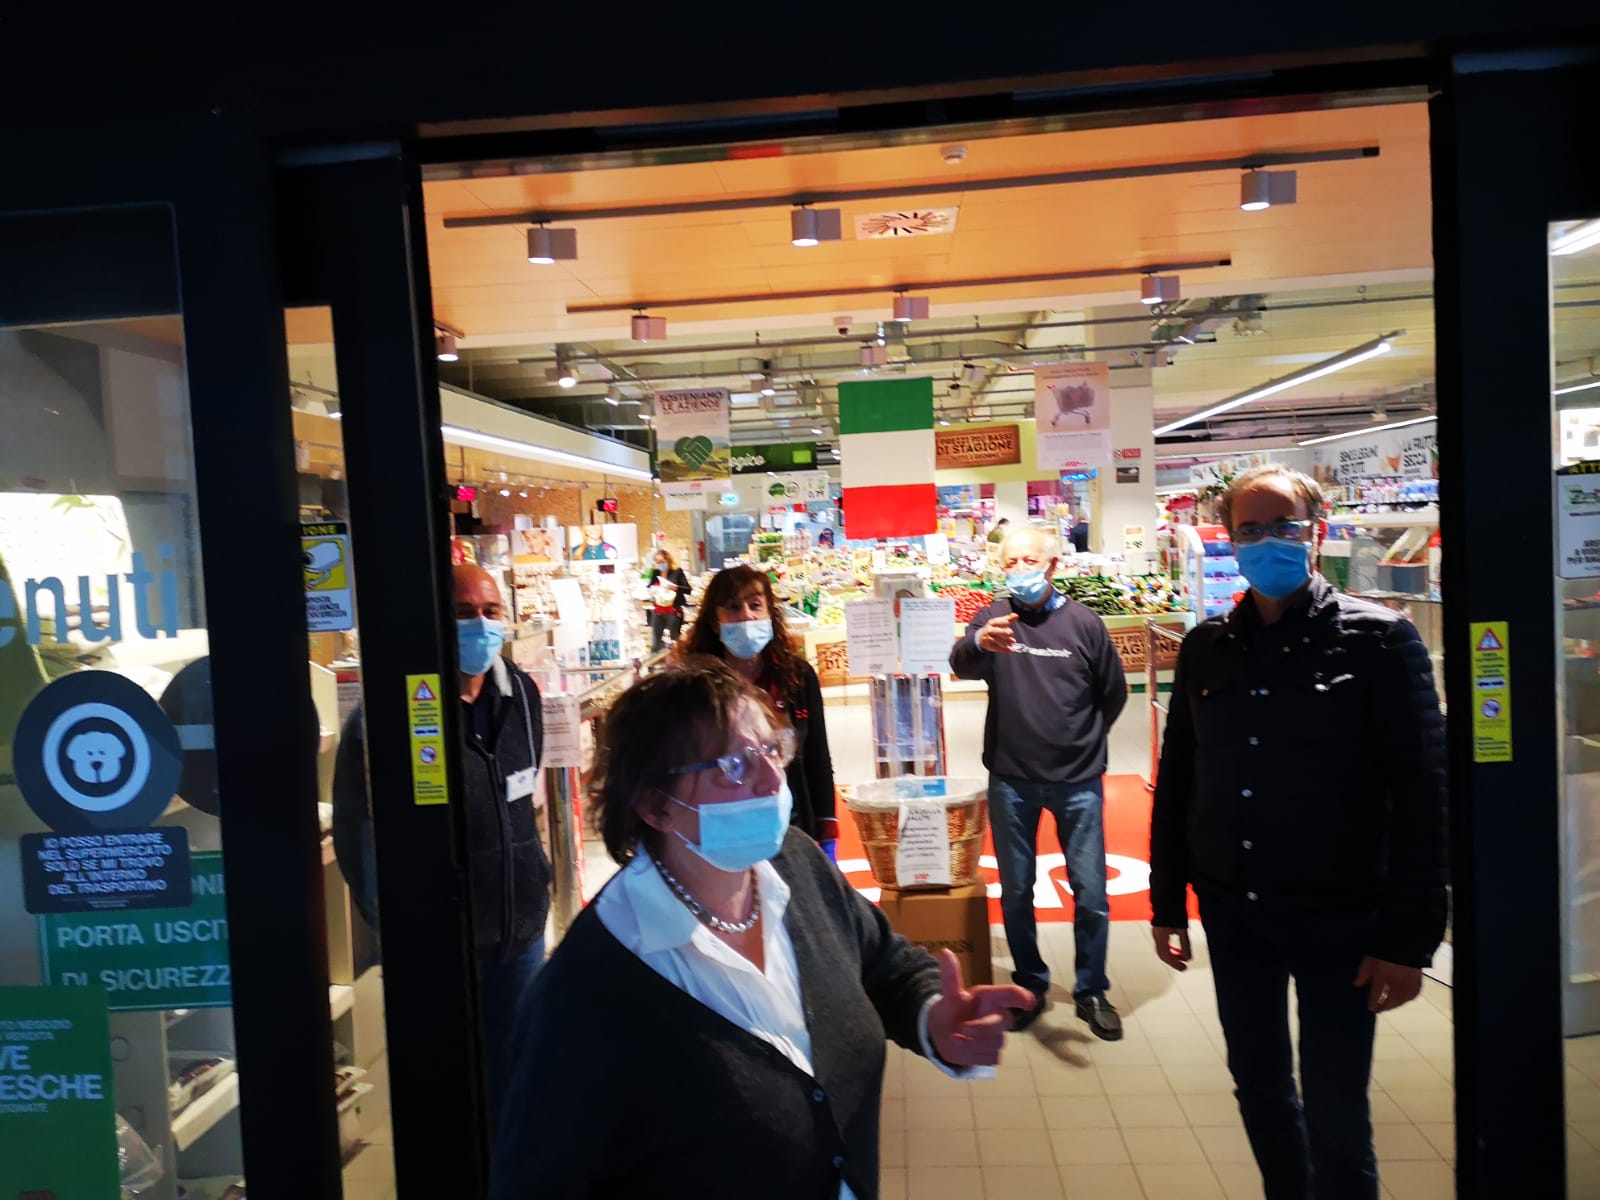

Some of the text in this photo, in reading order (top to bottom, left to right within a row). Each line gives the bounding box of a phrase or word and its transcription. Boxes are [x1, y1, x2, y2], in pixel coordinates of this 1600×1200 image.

[660, 391, 723, 401] SOSTENIAMO
[937, 438, 1014, 456] DI STAGIONE
[59, 835, 104, 848] POSSO
[104, 832, 164, 846] ENTRARE
[38, 844, 173, 861] NEL SUPERMERCATO
[44, 860, 81, 872] SOLO
[81, 858, 101, 870] SE
[119, 855, 165, 869] TROVO
[48, 879, 168, 895] DEL TRASPORTINO
[58, 923, 145, 949] PORTA
[0, 1074, 104, 1101] ESCHE
